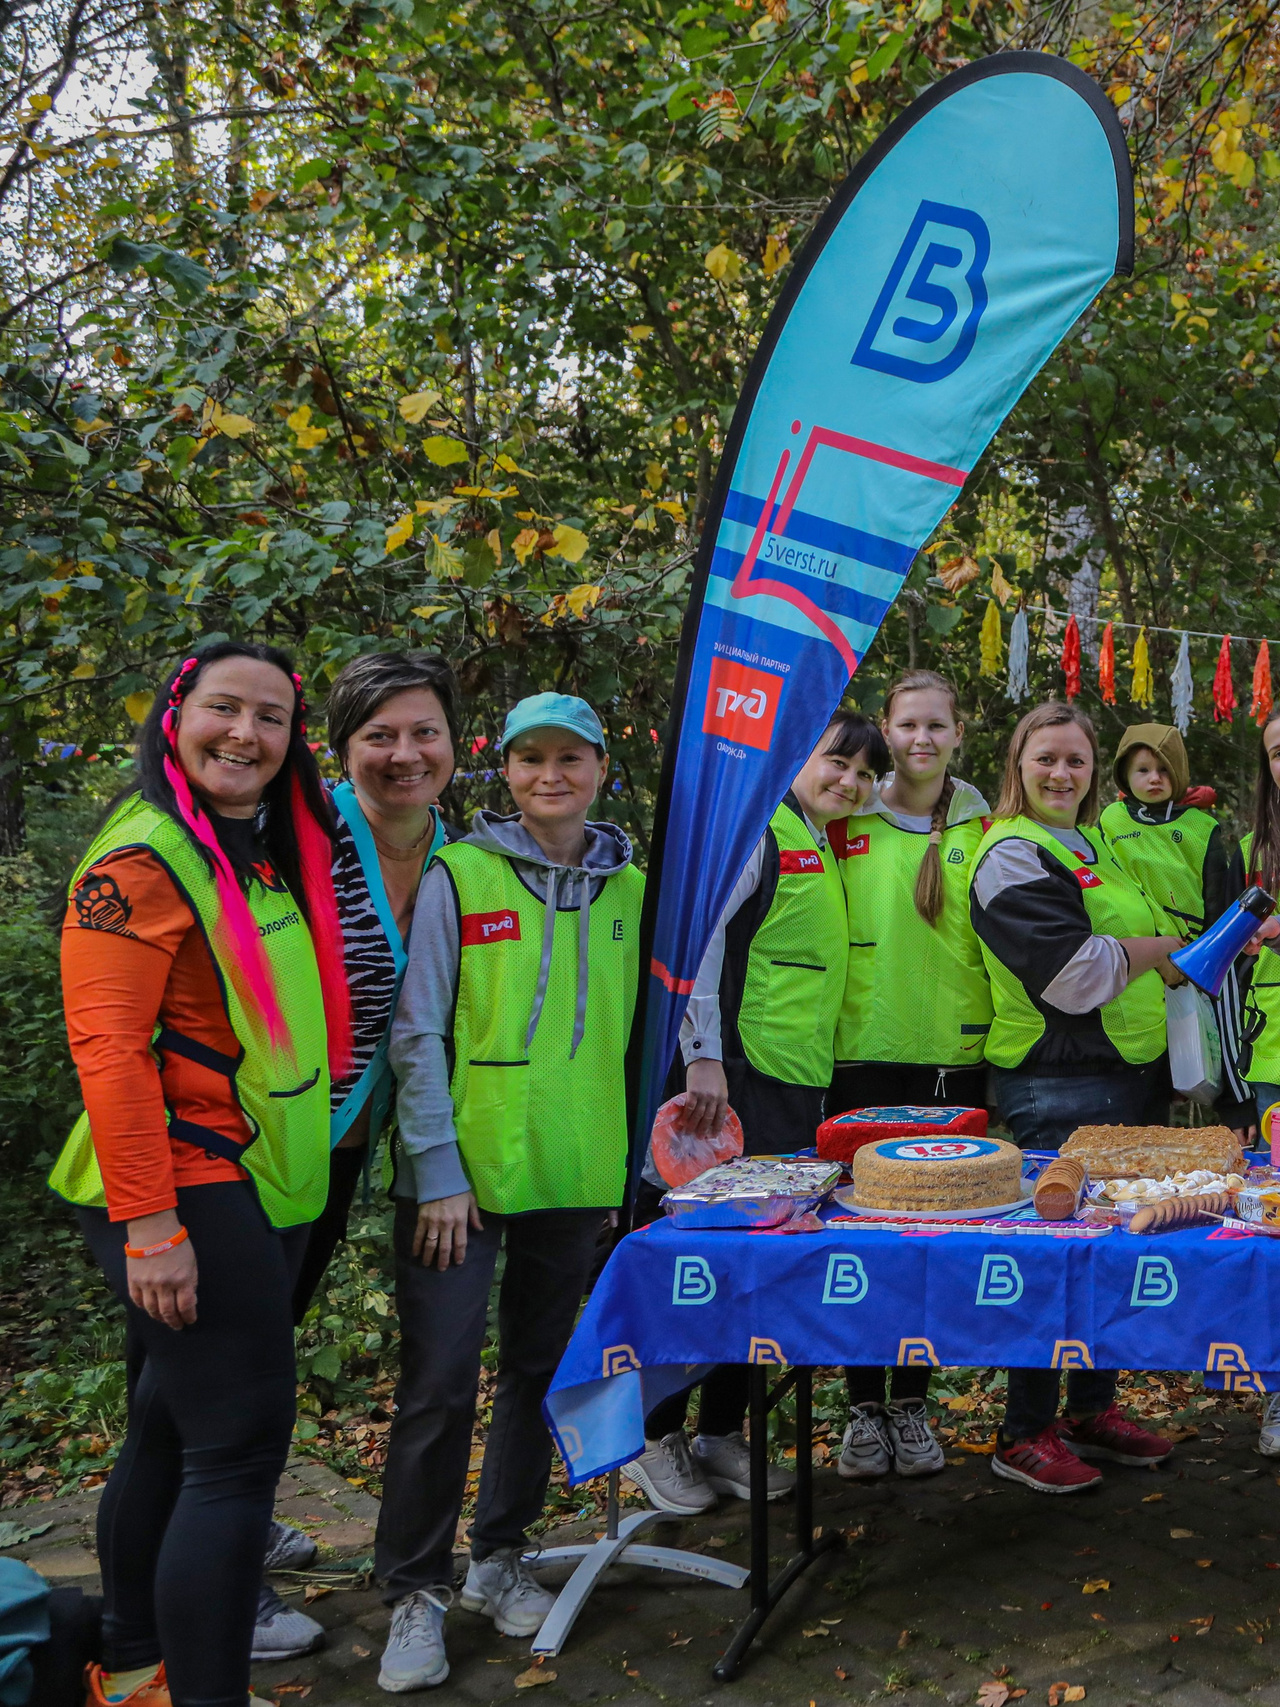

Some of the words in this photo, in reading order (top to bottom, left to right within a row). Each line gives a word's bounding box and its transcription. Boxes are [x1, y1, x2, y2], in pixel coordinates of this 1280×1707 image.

[765, 536, 838, 579] 5verst.ru
[760, 656, 791, 674] ПАРТНЕР
[258, 911, 300, 938] олонтёр
